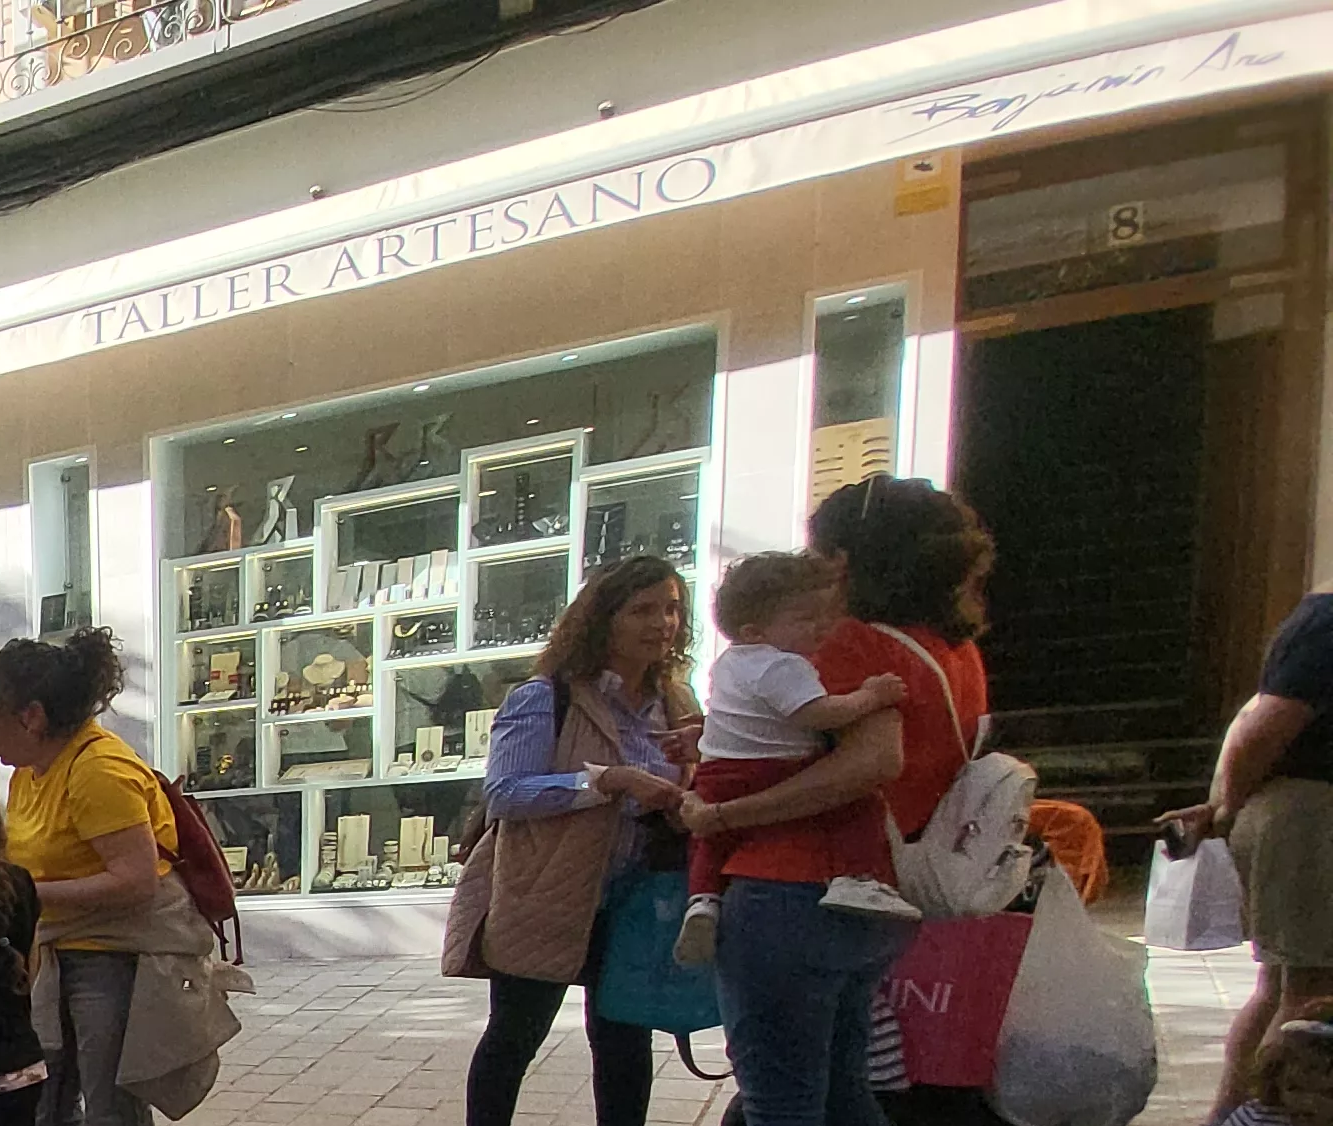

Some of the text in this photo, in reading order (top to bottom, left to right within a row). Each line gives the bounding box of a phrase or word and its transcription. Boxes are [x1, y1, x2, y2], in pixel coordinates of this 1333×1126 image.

[1181, 32, 1288, 81] Ara
[1112, 206, 1140, 240] 8
[81, 157, 717, 345] TALLER ARTESANO
[878, 977, 954, 1013] INI
